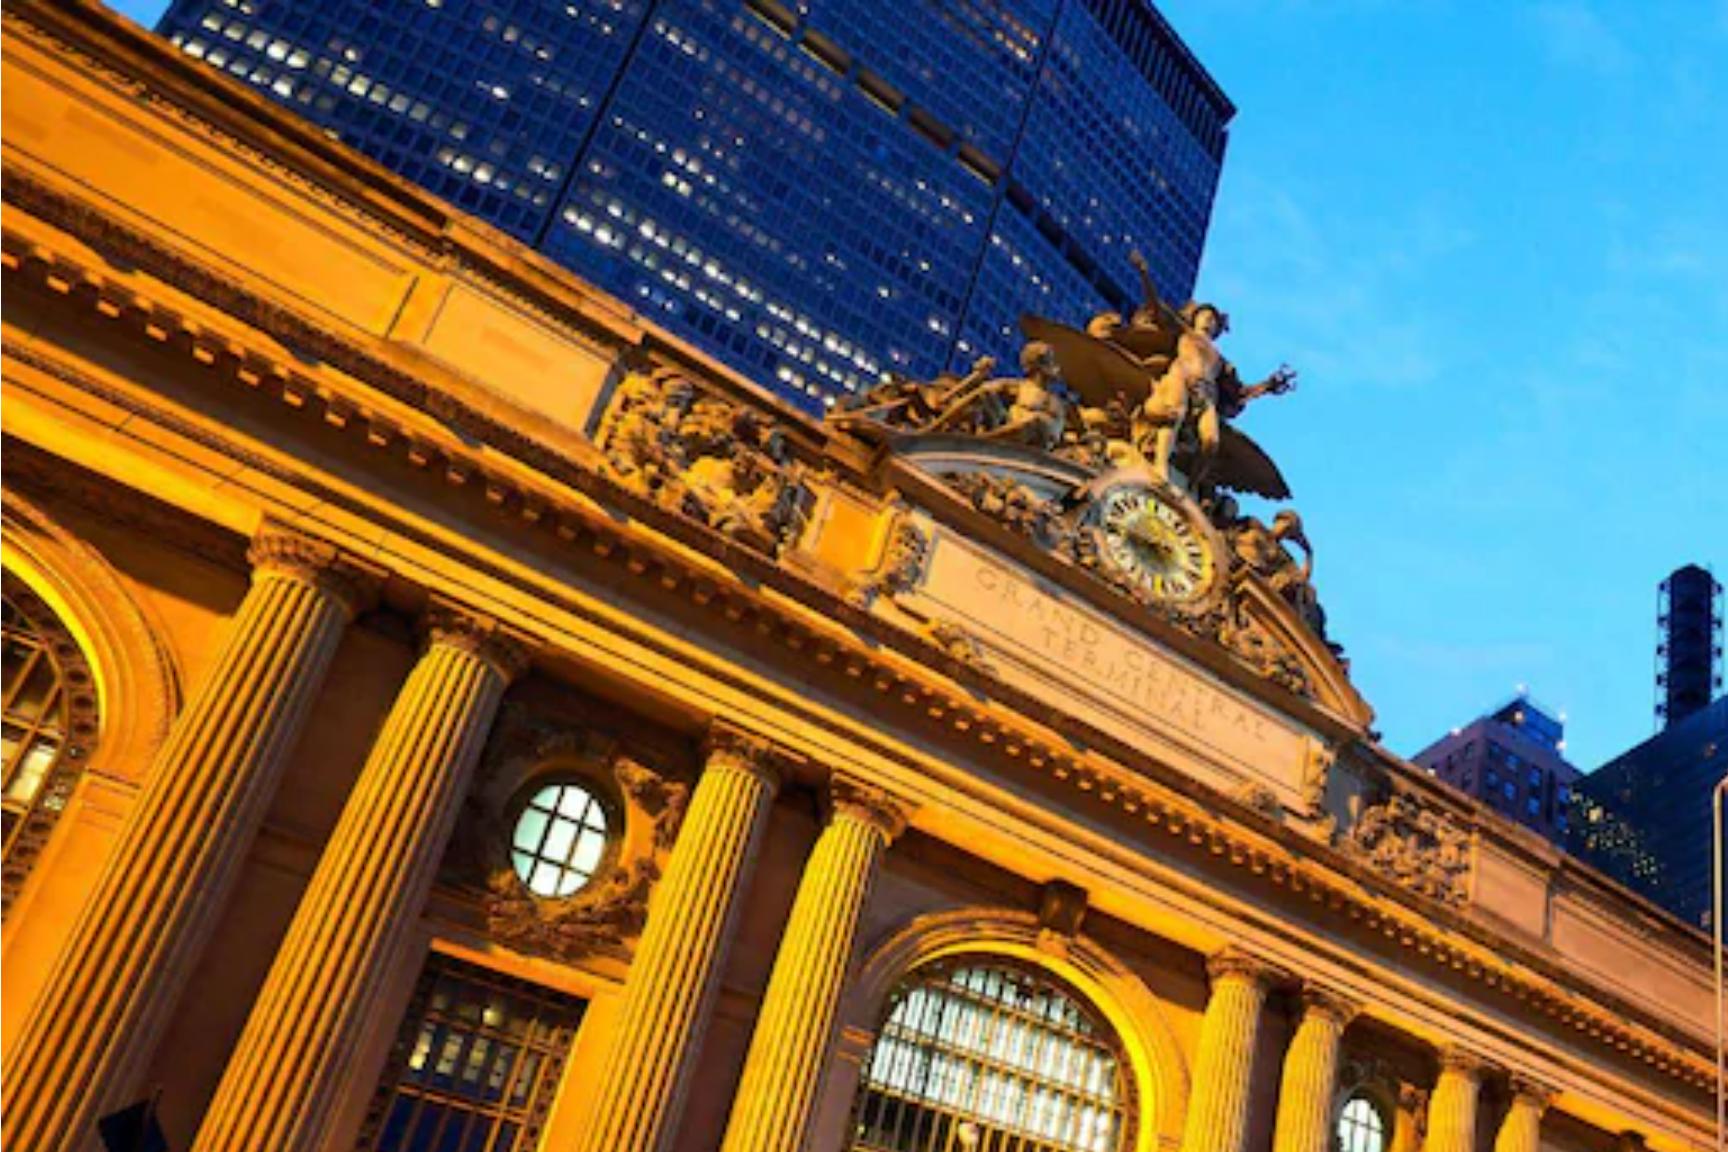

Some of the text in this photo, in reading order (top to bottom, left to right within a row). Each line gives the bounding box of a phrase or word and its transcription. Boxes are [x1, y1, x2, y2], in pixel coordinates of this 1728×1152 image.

[974, 567, 1266, 743] GRAND CENTRAL
[1043, 626, 1205, 730] TERMINAL
